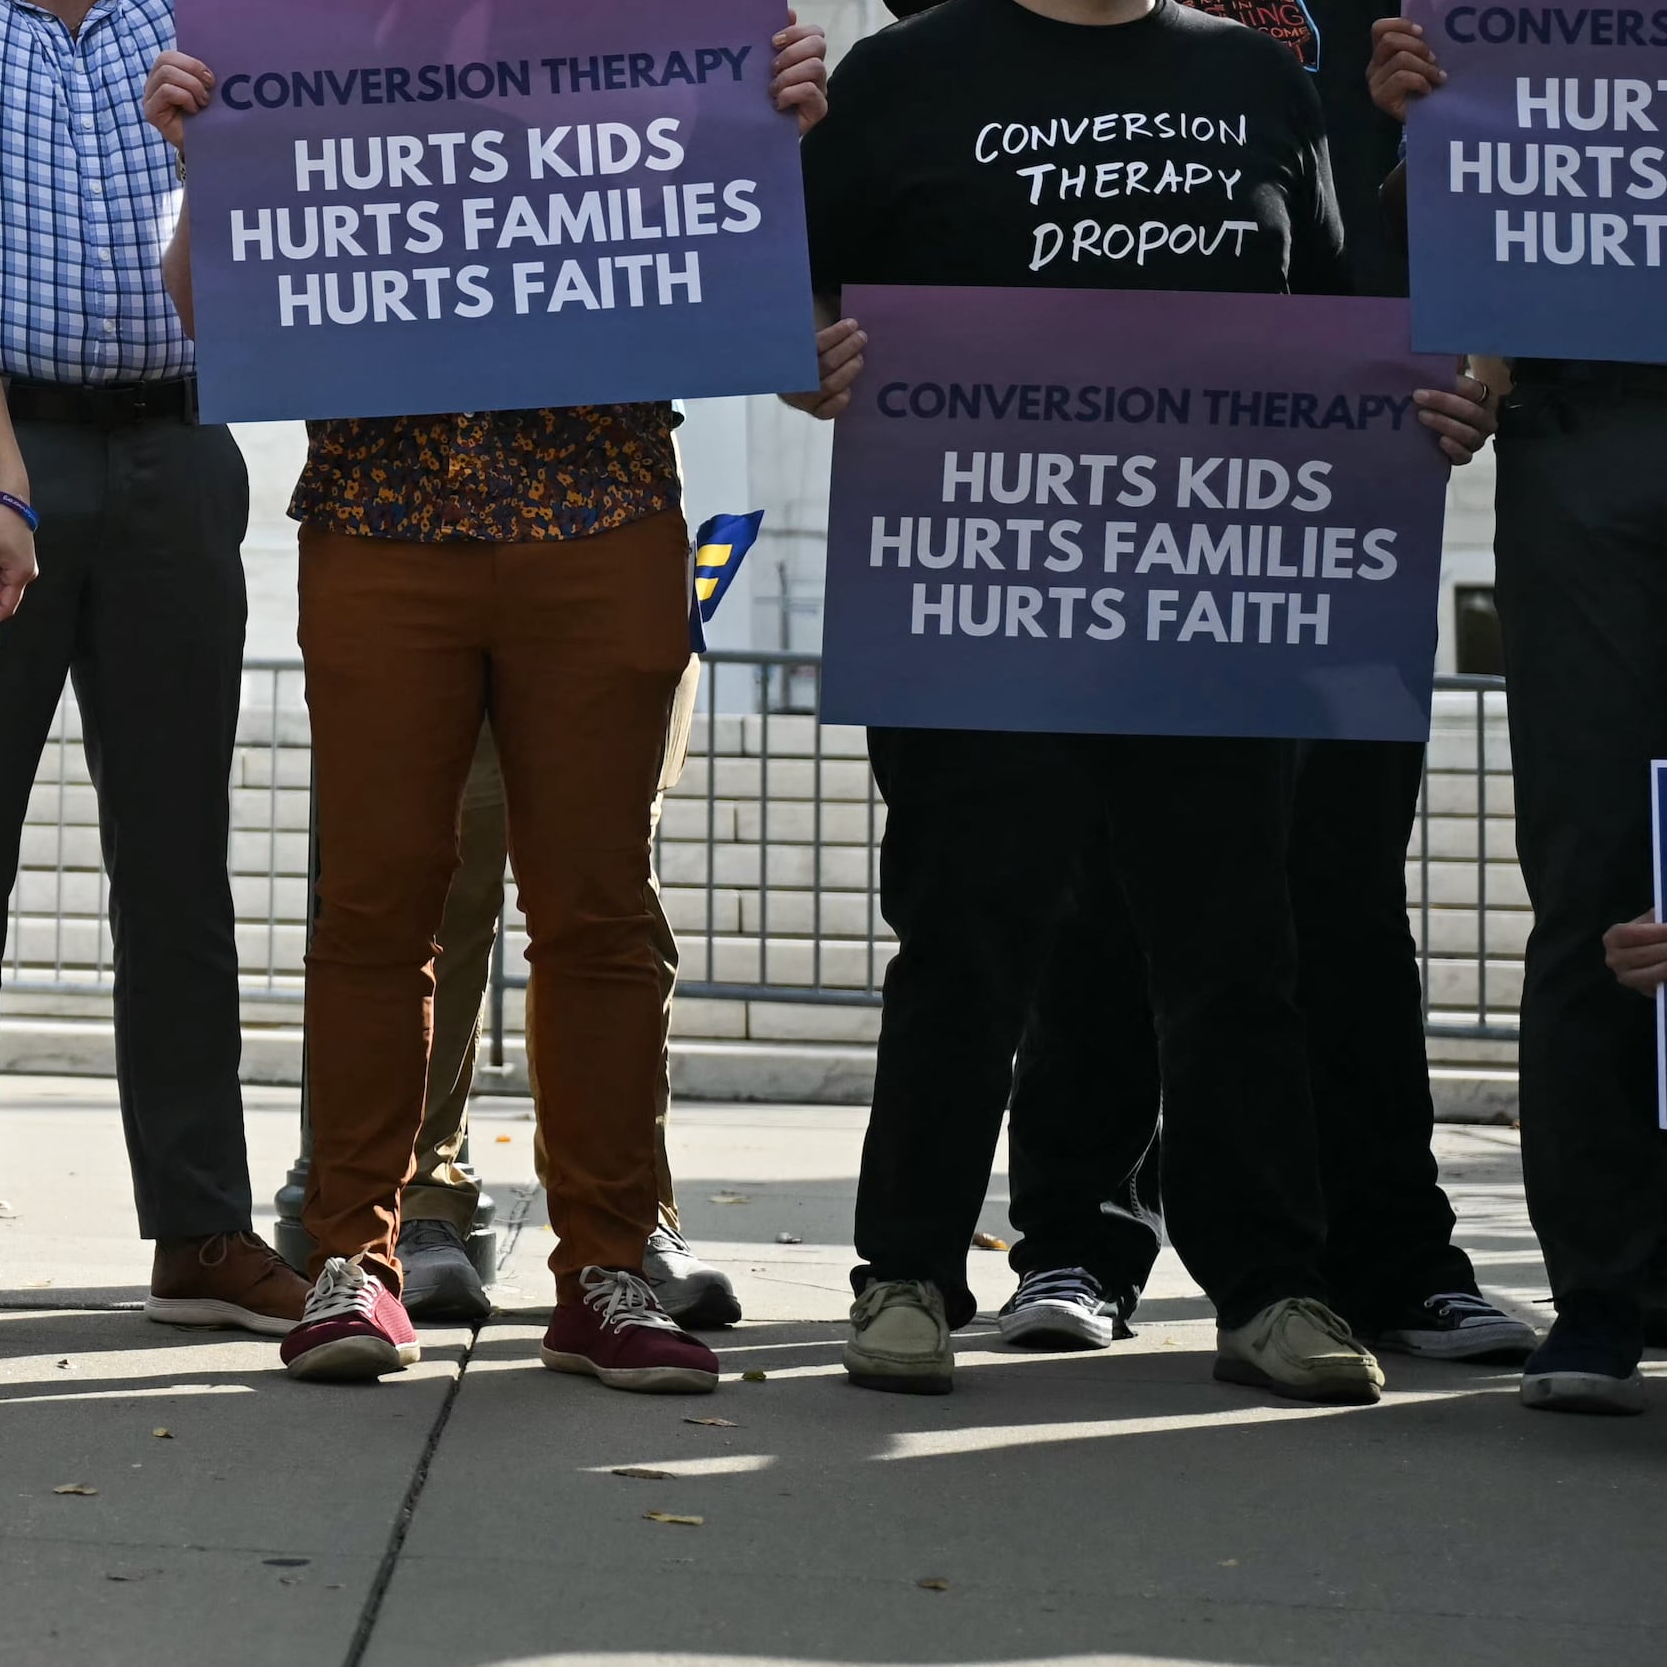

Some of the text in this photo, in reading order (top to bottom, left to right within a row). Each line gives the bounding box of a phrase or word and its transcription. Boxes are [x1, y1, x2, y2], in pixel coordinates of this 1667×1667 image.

[220, 45, 752, 110] CONVERSION THERAPY
[1516, 77, 1667, 132] HUR
[294, 117, 686, 192] HURTS KIDS
[975, 113, 1248, 163] CONVERSION
[1016, 163, 1244, 206] THERAPY
[1449, 140, 1667, 200] HURTS
[229, 179, 762, 261] HURTS FAMILIES
[1028, 219, 1259, 272] DROPOUT
[277, 251, 703, 326] HURTS FAITH
[876, 381, 1413, 431] CONVERSION THERAPY
[941, 451, 1333, 513] HURTS KIDS
[869, 516, 1399, 582] HURTS FAMILIES
[910, 583, 1331, 646] HURTS FAITH
